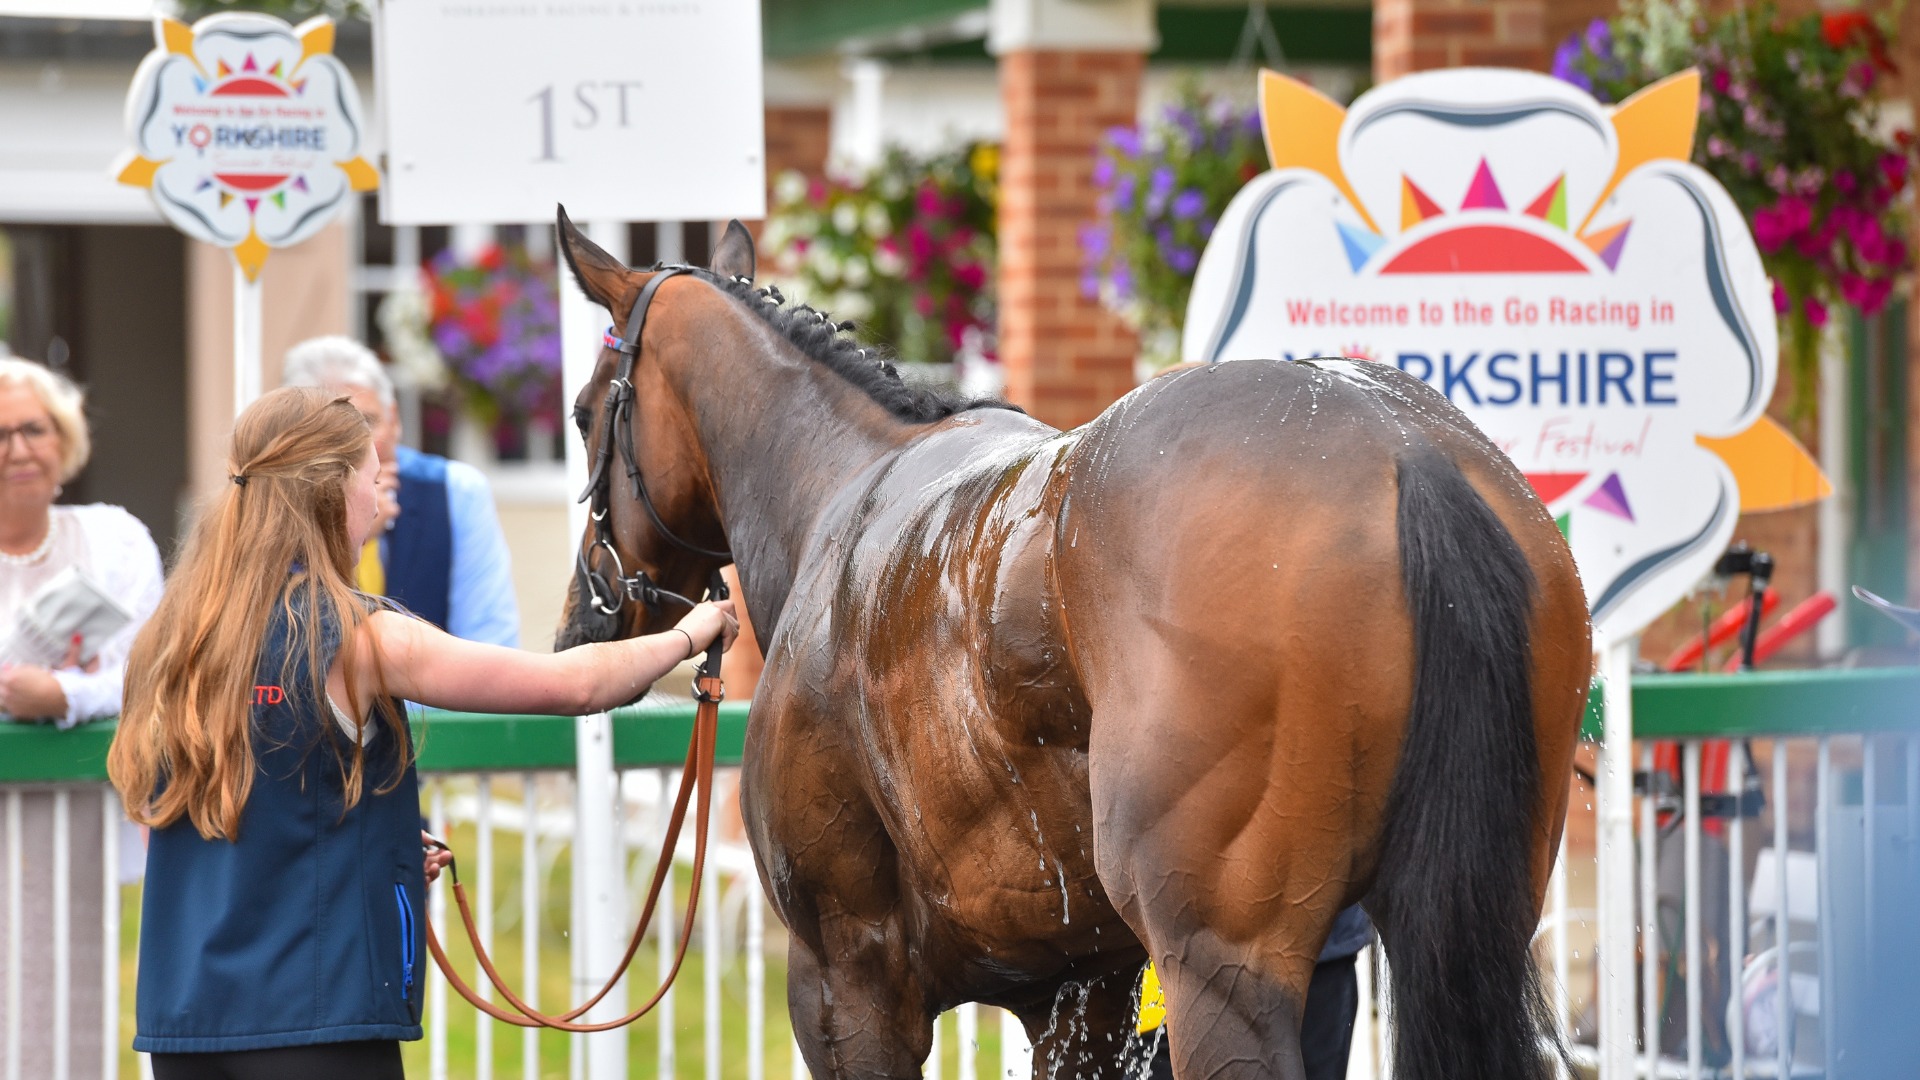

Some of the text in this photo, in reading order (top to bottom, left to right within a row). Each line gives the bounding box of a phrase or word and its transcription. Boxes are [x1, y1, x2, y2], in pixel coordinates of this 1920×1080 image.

[172, 124, 326, 151] YORKSHIRE
[526, 81, 643, 163] 1ST
[1287, 297, 1675, 331] Welcome to the Go Racing in
[1533, 406, 1652, 462] Festival
